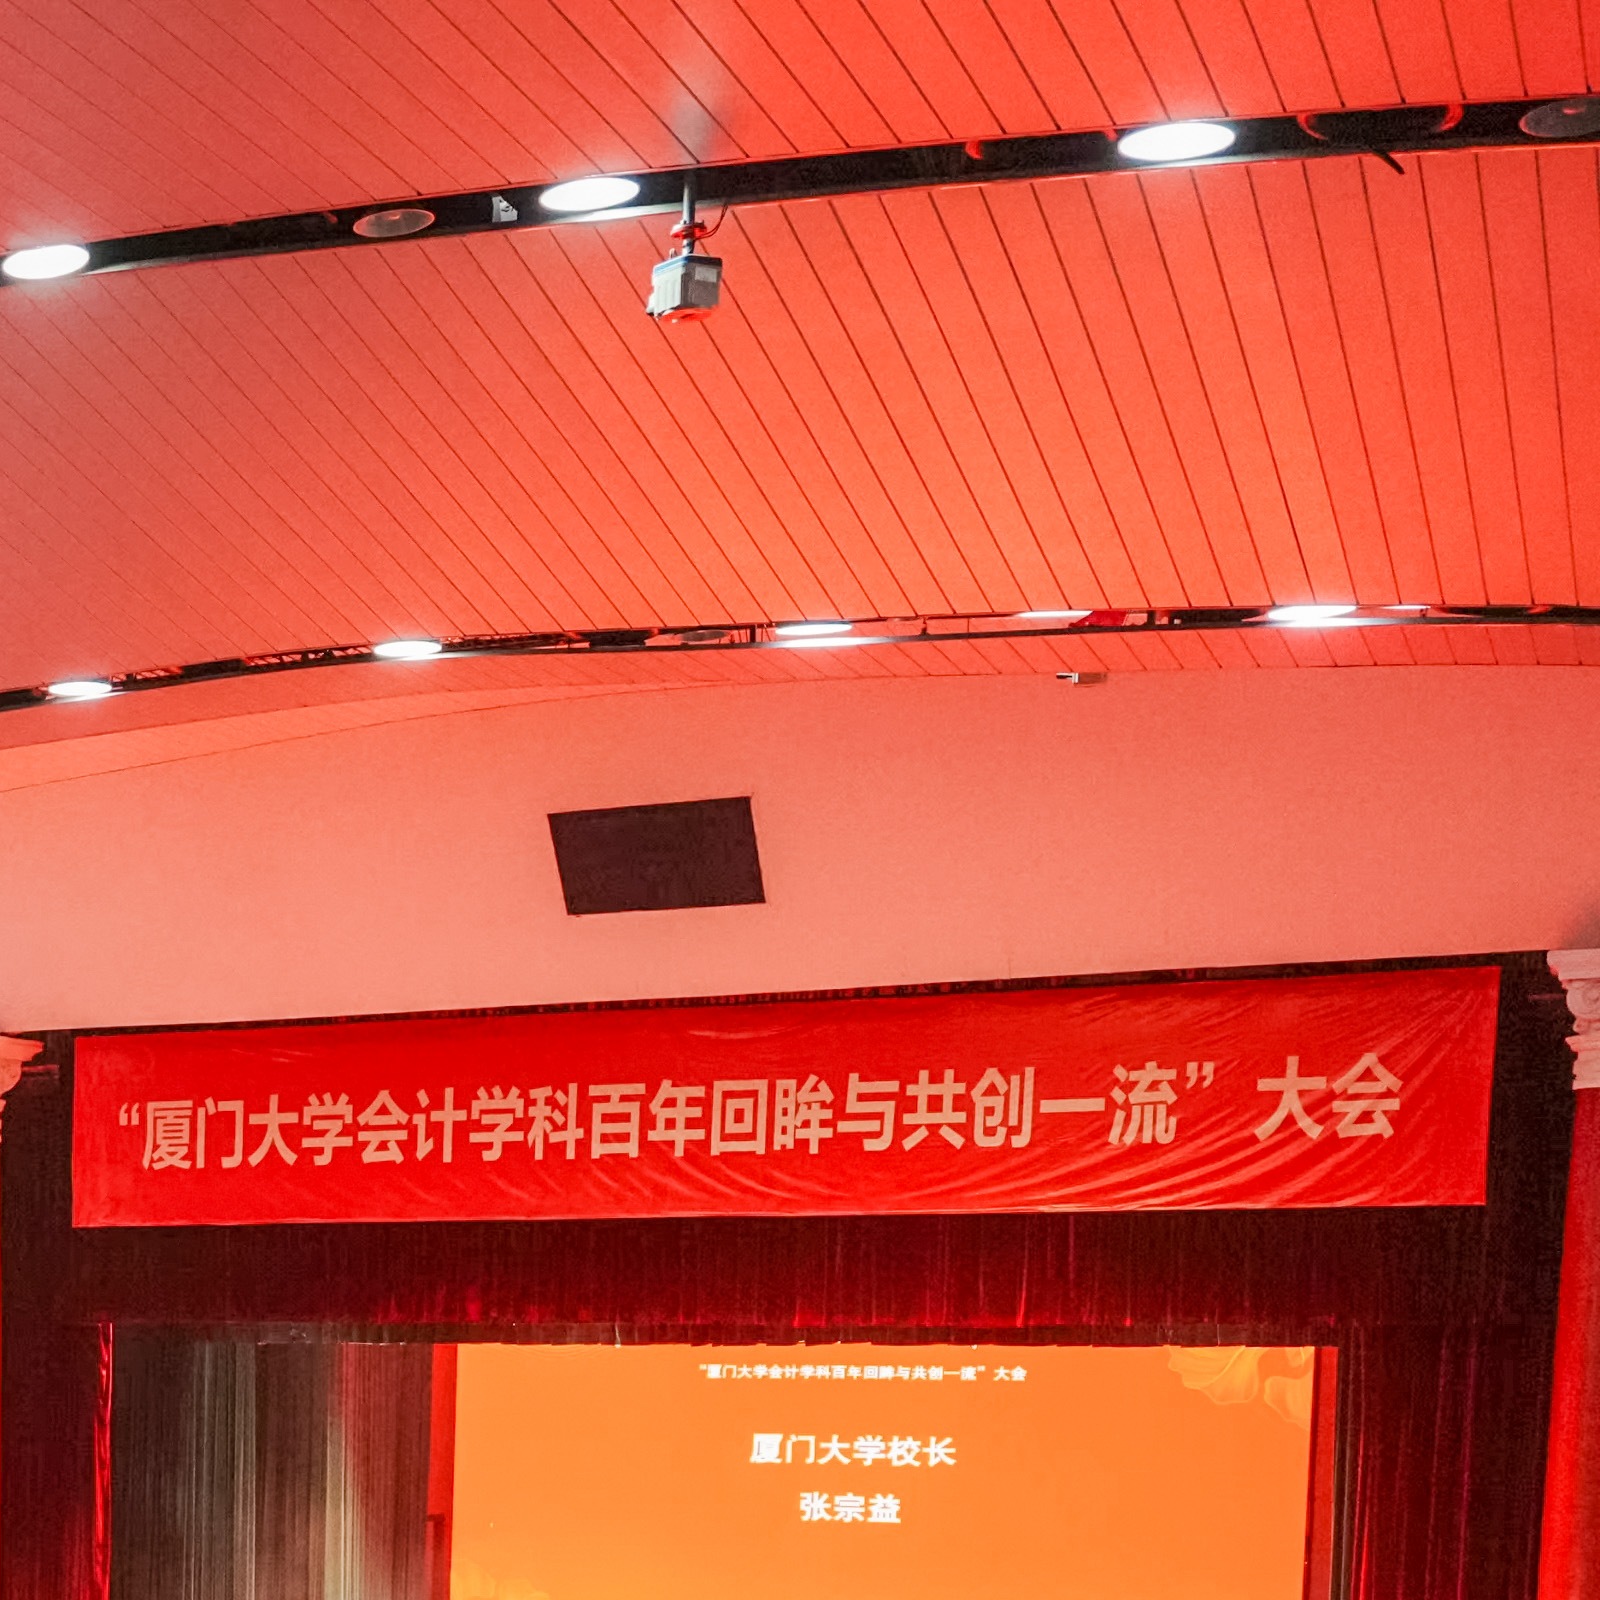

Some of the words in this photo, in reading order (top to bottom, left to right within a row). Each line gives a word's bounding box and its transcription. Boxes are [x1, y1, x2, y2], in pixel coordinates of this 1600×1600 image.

[750, 1433, 957, 1467] 厦门大学校长
[800, 1491, 901, 1523] 张宗益
